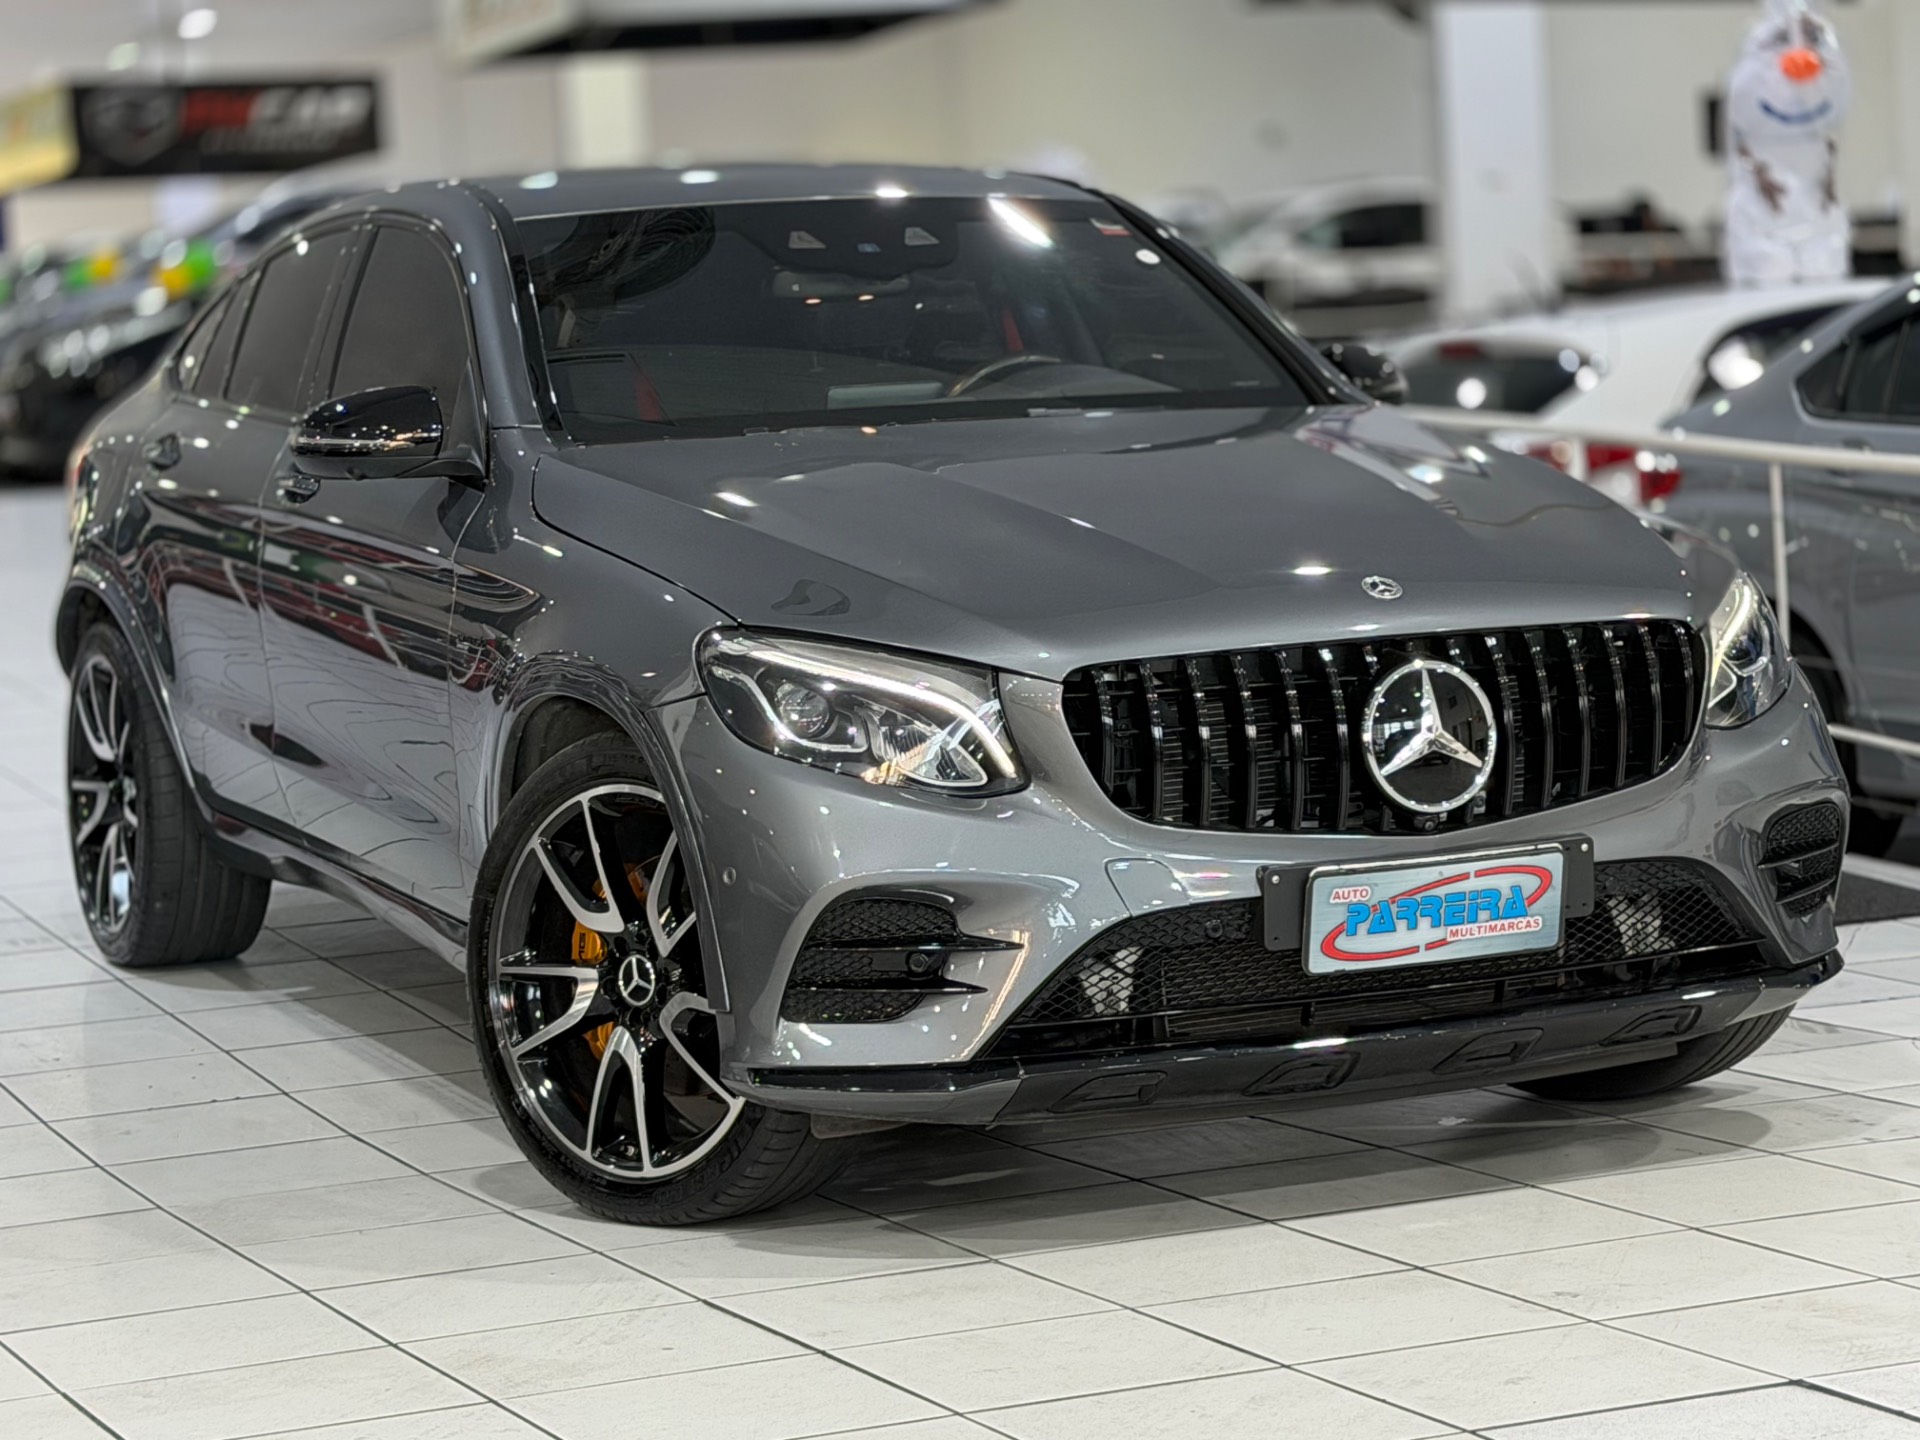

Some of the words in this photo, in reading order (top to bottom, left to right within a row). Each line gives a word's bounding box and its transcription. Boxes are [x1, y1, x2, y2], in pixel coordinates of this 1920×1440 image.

[1332, 888, 1369, 901] AUTO
[1345, 885, 1528, 937] PARREIRA
[1448, 917, 1541, 939] MULTIMARCAS
